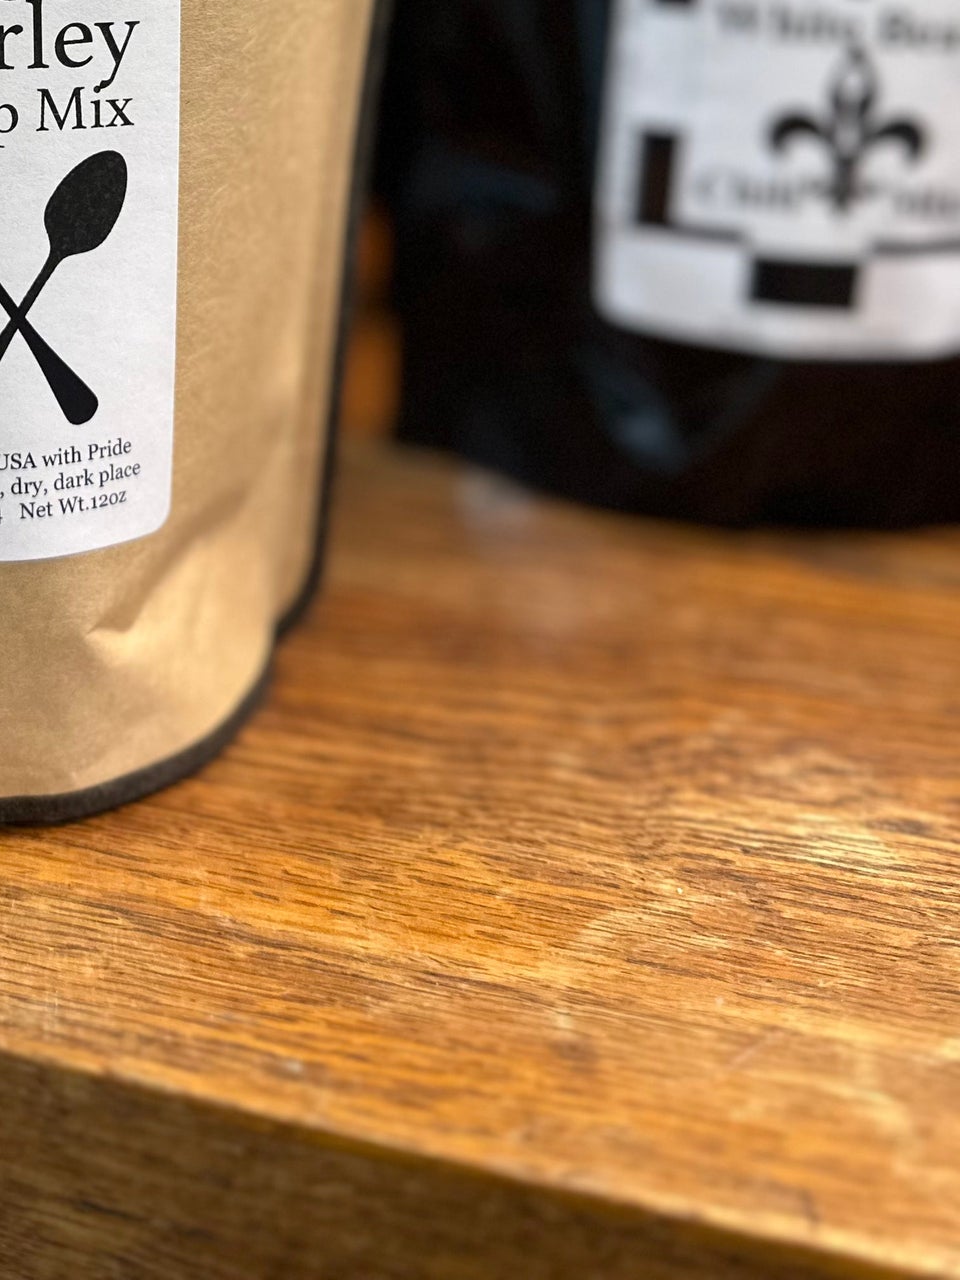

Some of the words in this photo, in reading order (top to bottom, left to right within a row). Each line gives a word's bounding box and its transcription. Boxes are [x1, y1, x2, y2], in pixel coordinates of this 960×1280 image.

[36, 85, 135, 132] Mix
[42, 446, 82, 468] with
[88, 438, 132, 461] Pride
[10, 475, 48, 497] dry,
[53, 469, 94, 491] dark
[99, 461, 141, 487] place
[20, 500, 53, 520] Net
[58, 489, 128, 516] Wt.12oz
